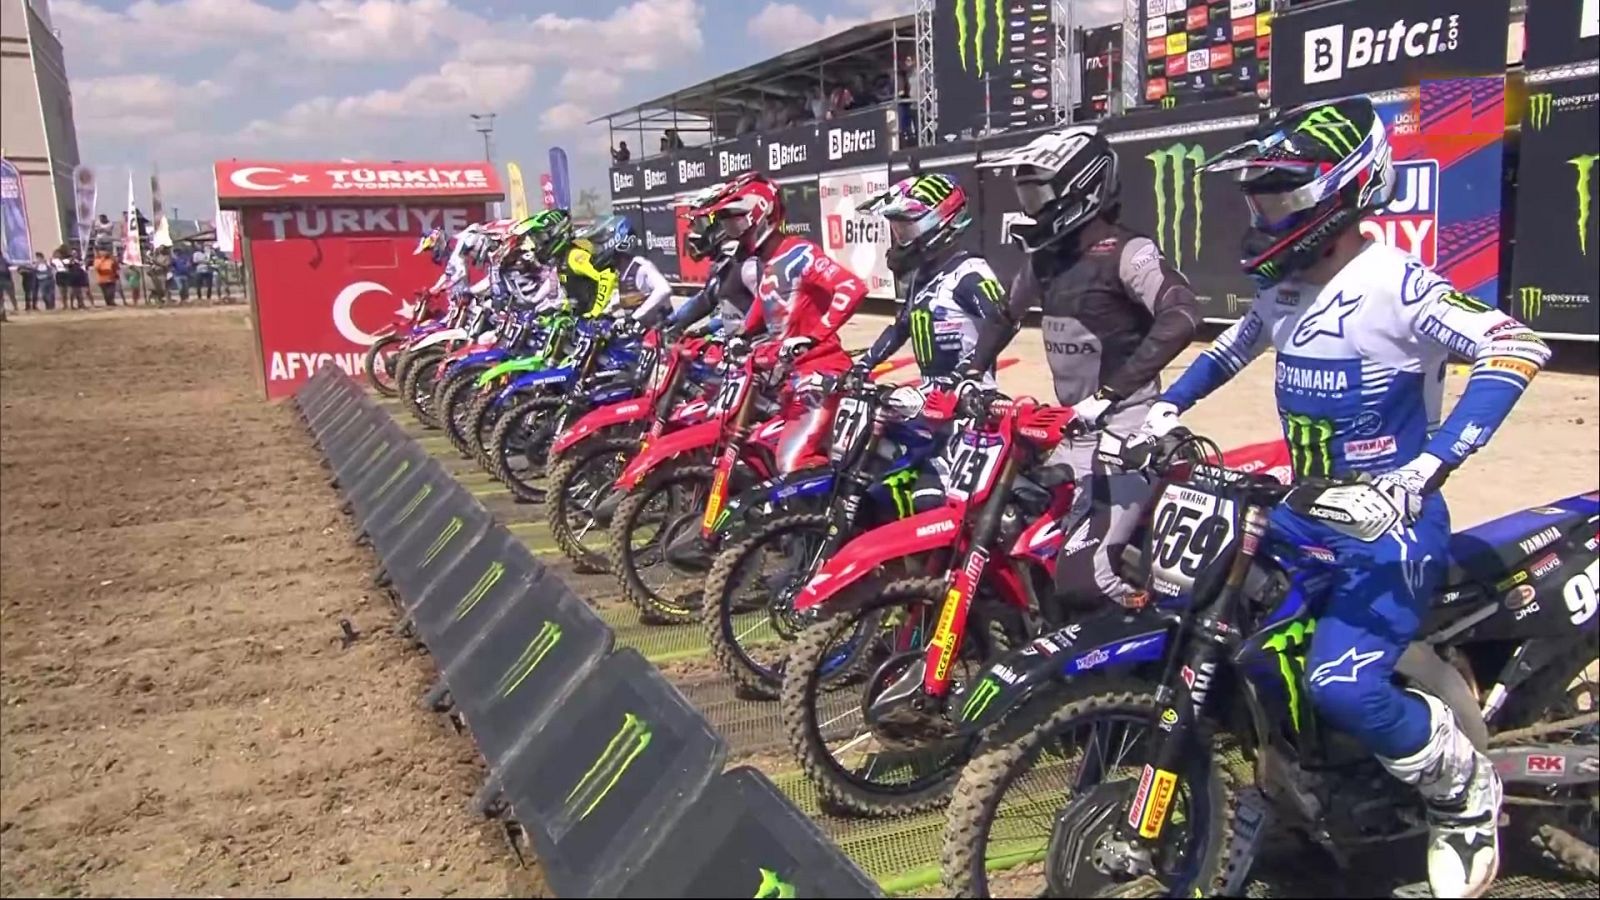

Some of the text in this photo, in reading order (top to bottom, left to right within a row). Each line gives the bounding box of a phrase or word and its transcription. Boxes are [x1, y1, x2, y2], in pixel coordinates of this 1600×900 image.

[1347, 18, 1441, 69] Bitci
[843, 130, 872, 153] Bitci
[325, 168, 487, 183] TÜRKİYE
[263, 204, 468, 241] TÜRKİYE
[846, 218, 879, 244] Bitci
[1542, 293, 1591, 303] MONSTER
[1422, 317, 1476, 359] YAMAHA
[1286, 367, 1349, 391] YAMAHA
[916, 519, 956, 537] MOTUL
[1153, 502, 1229, 578] 959
[1519, 526, 1562, 555] YAMAHA
[1534, 557, 1561, 577] WILVO
[1564, 572, 1600, 626] 9
[1528, 756, 1563, 771] RK
[1130, 765, 1152, 826] BRAKING
